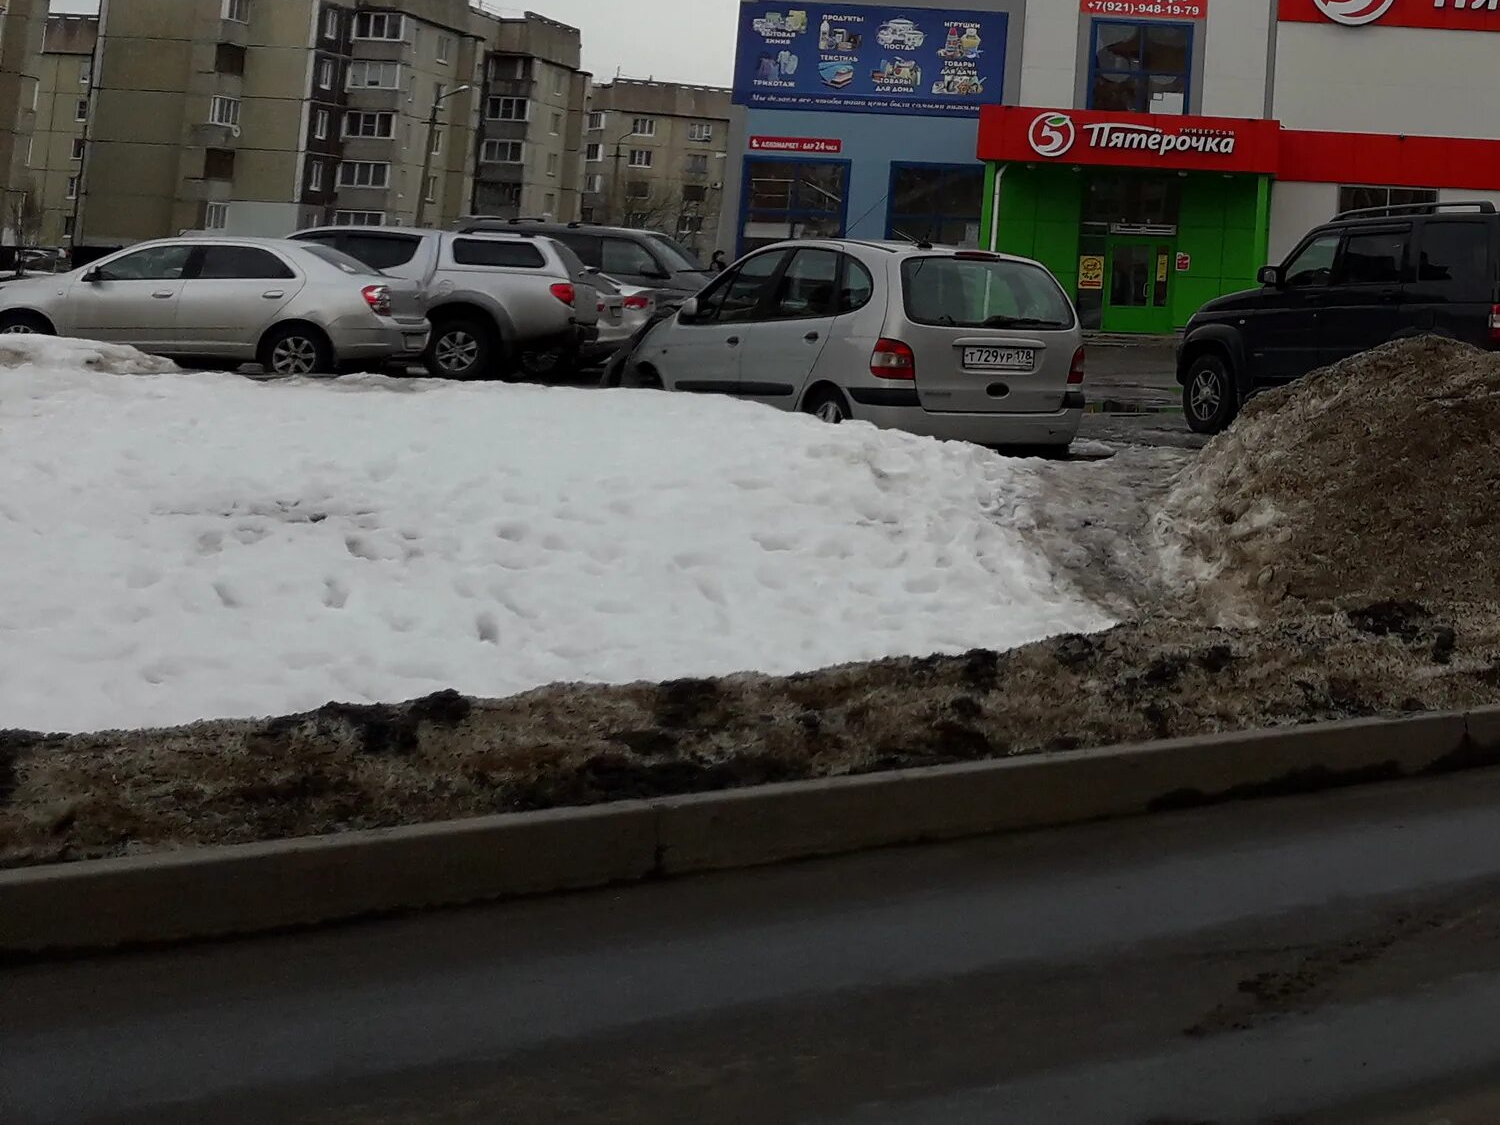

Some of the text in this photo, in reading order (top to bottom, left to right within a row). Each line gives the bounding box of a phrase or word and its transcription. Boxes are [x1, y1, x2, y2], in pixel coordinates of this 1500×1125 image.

[1087, 1, 1199, 15] +7(921)-948-19-79
[822, 14, 864, 22] ПРОДУКТЫ
[753, 79, 795, 87] ТРИКОТАЖ
[880, 77, 912, 85] ТОВАРЫ
[1179, 127, 1235, 136] УНИВЕРСАМ
[1082, 122, 1235, 156] Пятёрочка
[815, 141, 825, 151] 24
[1015, 350, 1031, 361] 178
